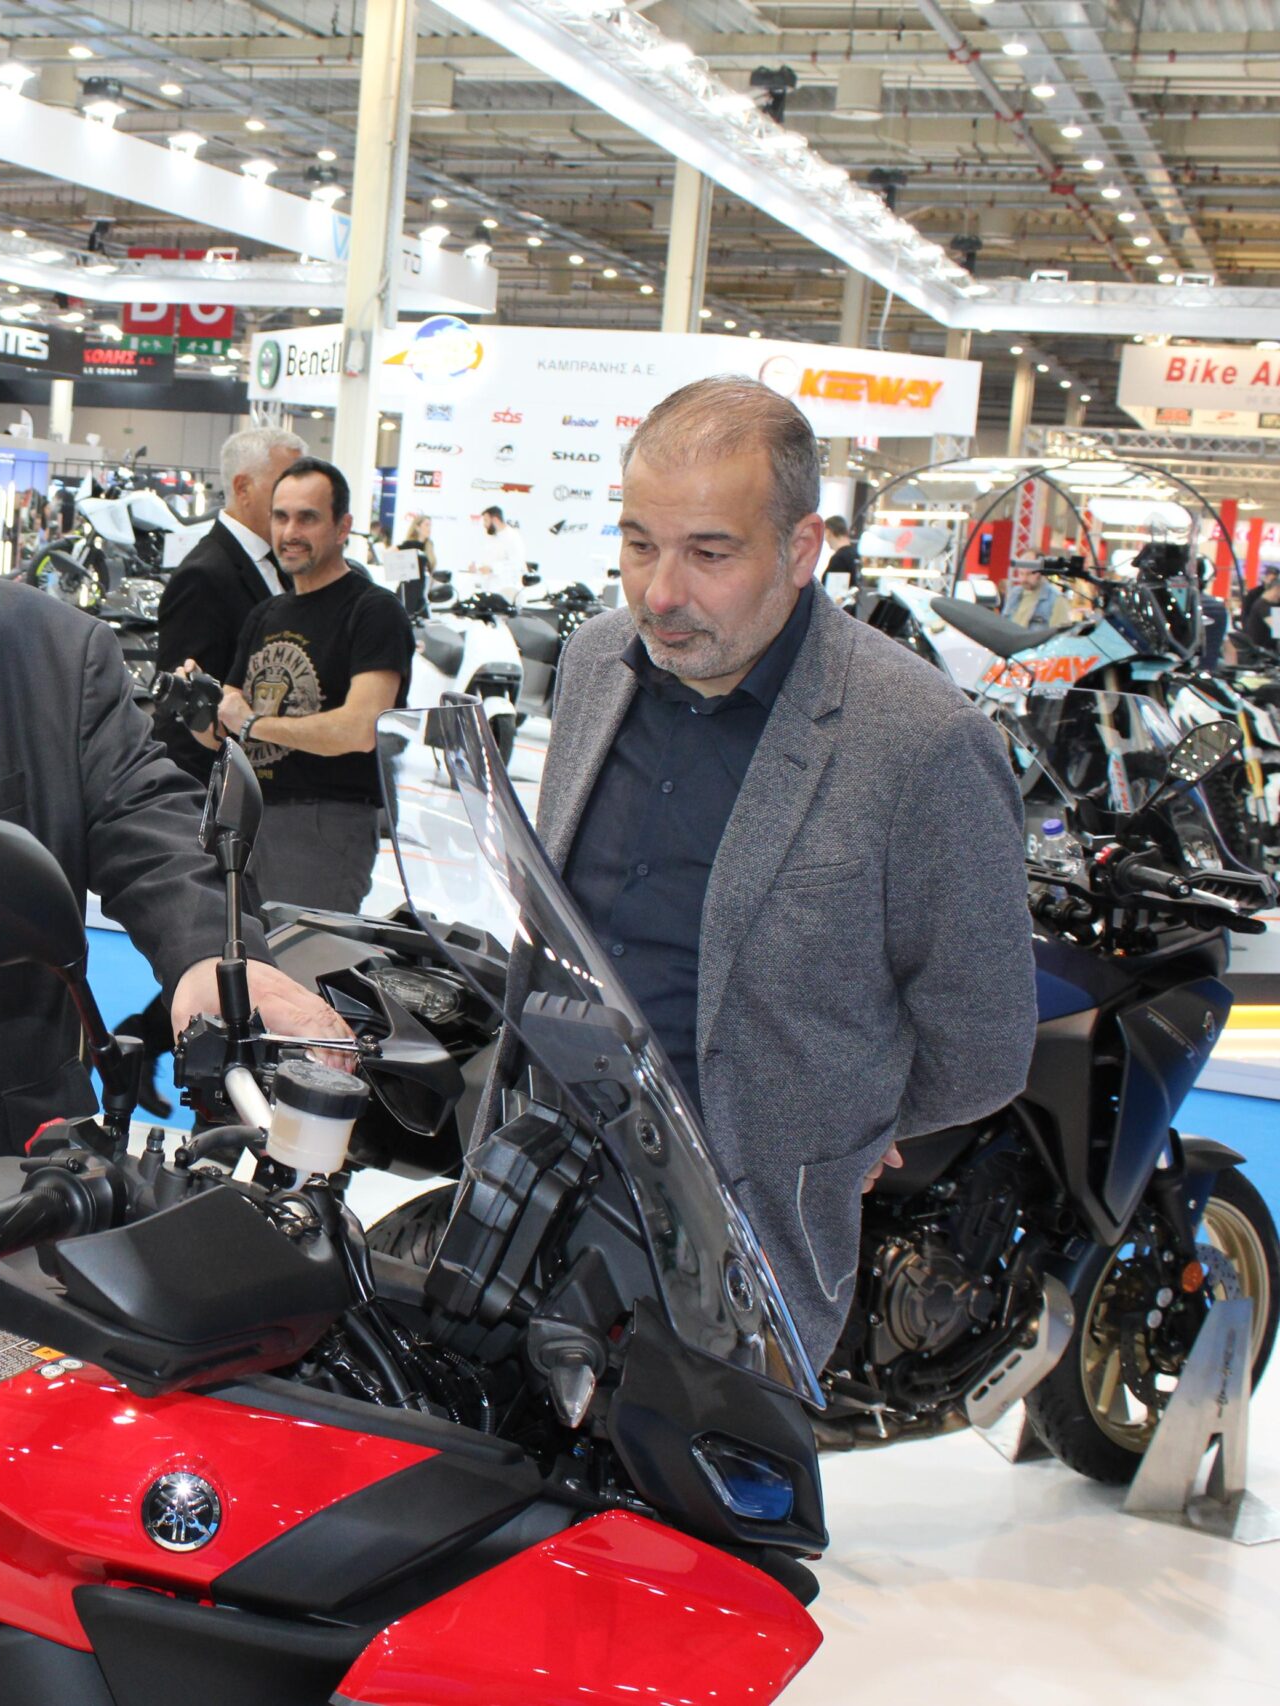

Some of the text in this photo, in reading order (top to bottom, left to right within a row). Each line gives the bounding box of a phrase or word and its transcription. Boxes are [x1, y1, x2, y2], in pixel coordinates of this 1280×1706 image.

[286, 342, 344, 376] Benell
[1166, 357, 1238, 385] Bike
[799, 368, 943, 408] KEEWAY
[552, 451, 600, 462] SHAD
